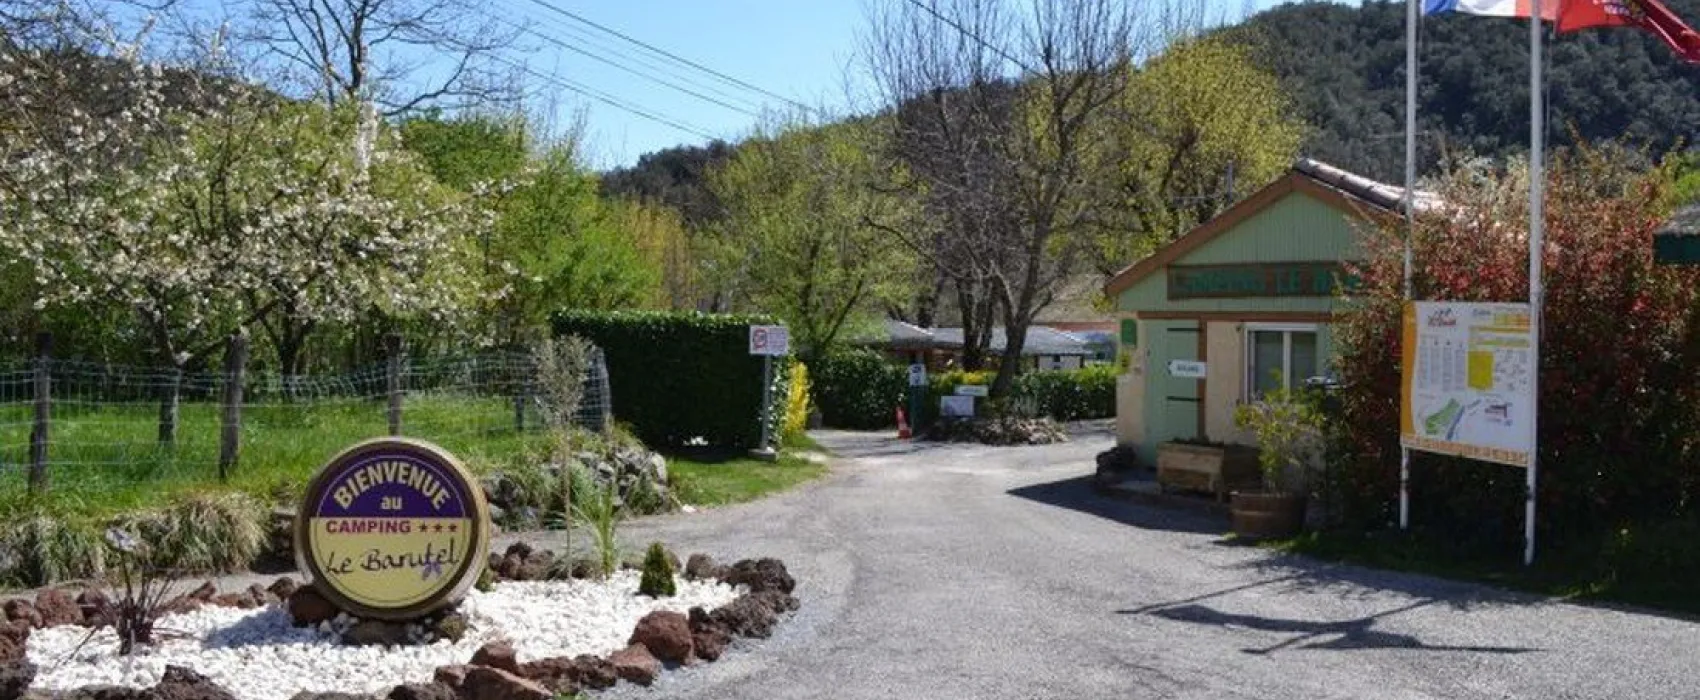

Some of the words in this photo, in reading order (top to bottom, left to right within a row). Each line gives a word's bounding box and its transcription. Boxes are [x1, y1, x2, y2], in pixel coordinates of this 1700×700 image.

[333, 461, 451, 510] BIENVENUE
[380, 495, 403, 510] au
[325, 520, 412, 534] CAMPING
[325, 551, 354, 575] Le
